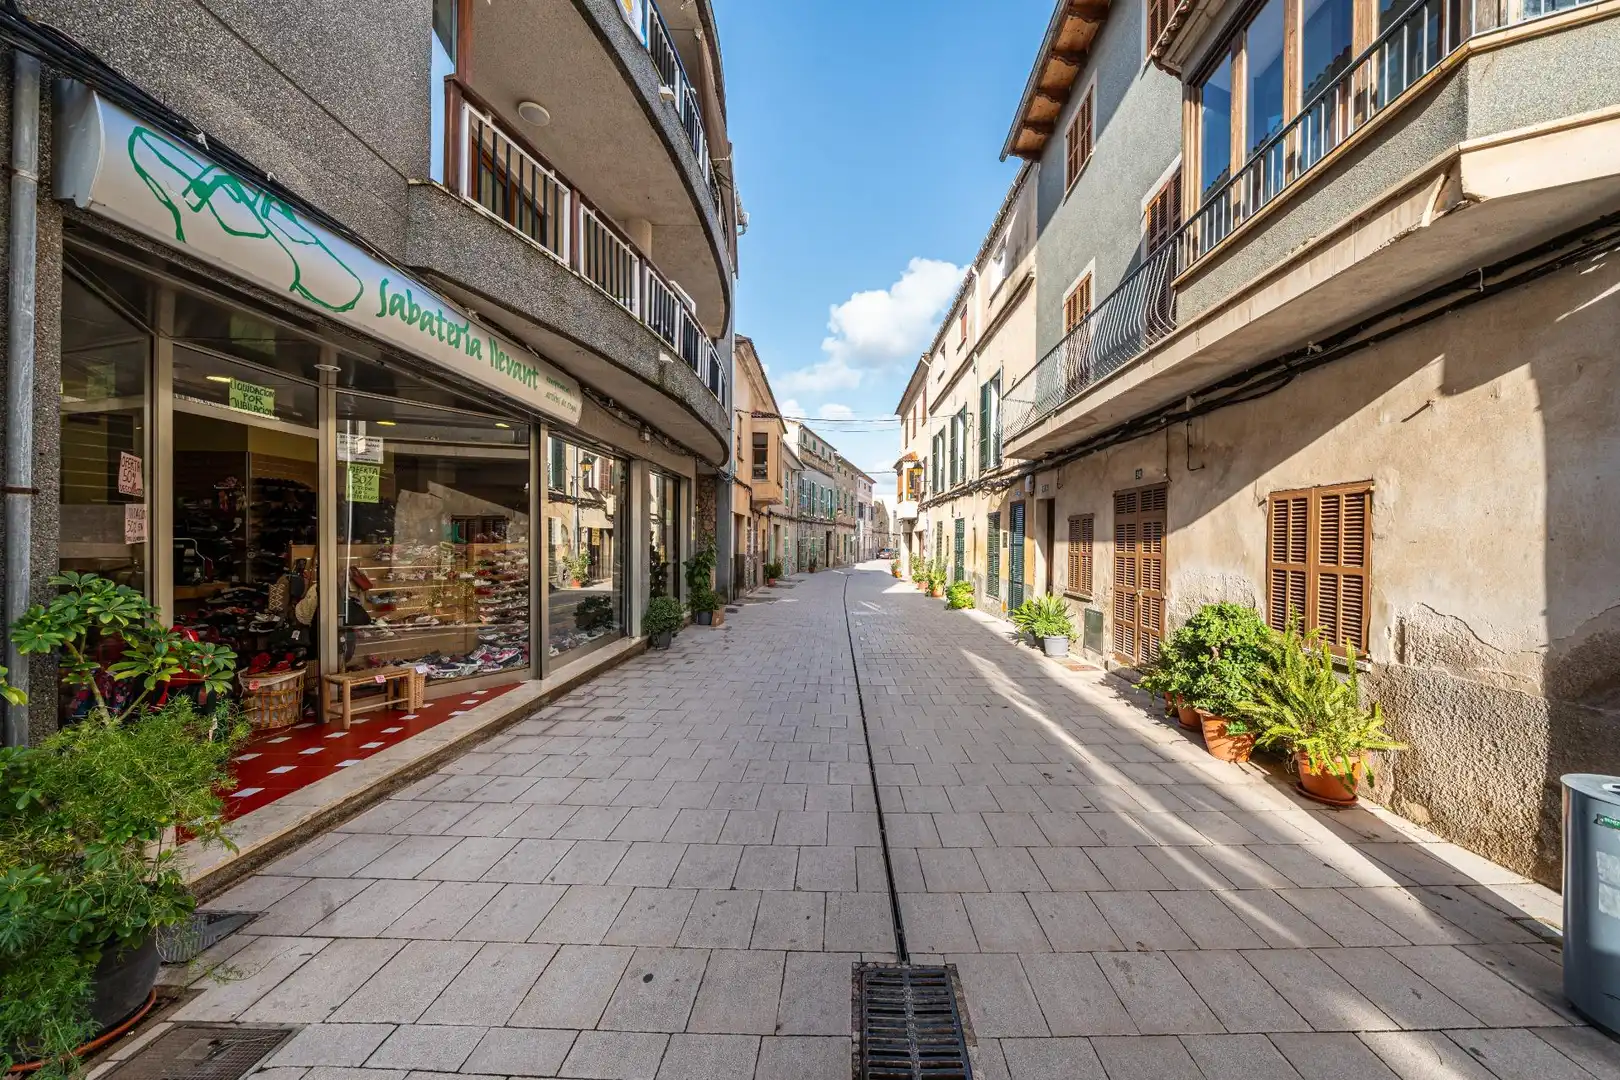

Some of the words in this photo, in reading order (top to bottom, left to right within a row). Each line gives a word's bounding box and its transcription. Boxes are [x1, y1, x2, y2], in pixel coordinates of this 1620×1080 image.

[243, 393, 264, 405] POR
[349, 465, 378, 476] OFERTA
[351, 473, 374, 487] 50%
